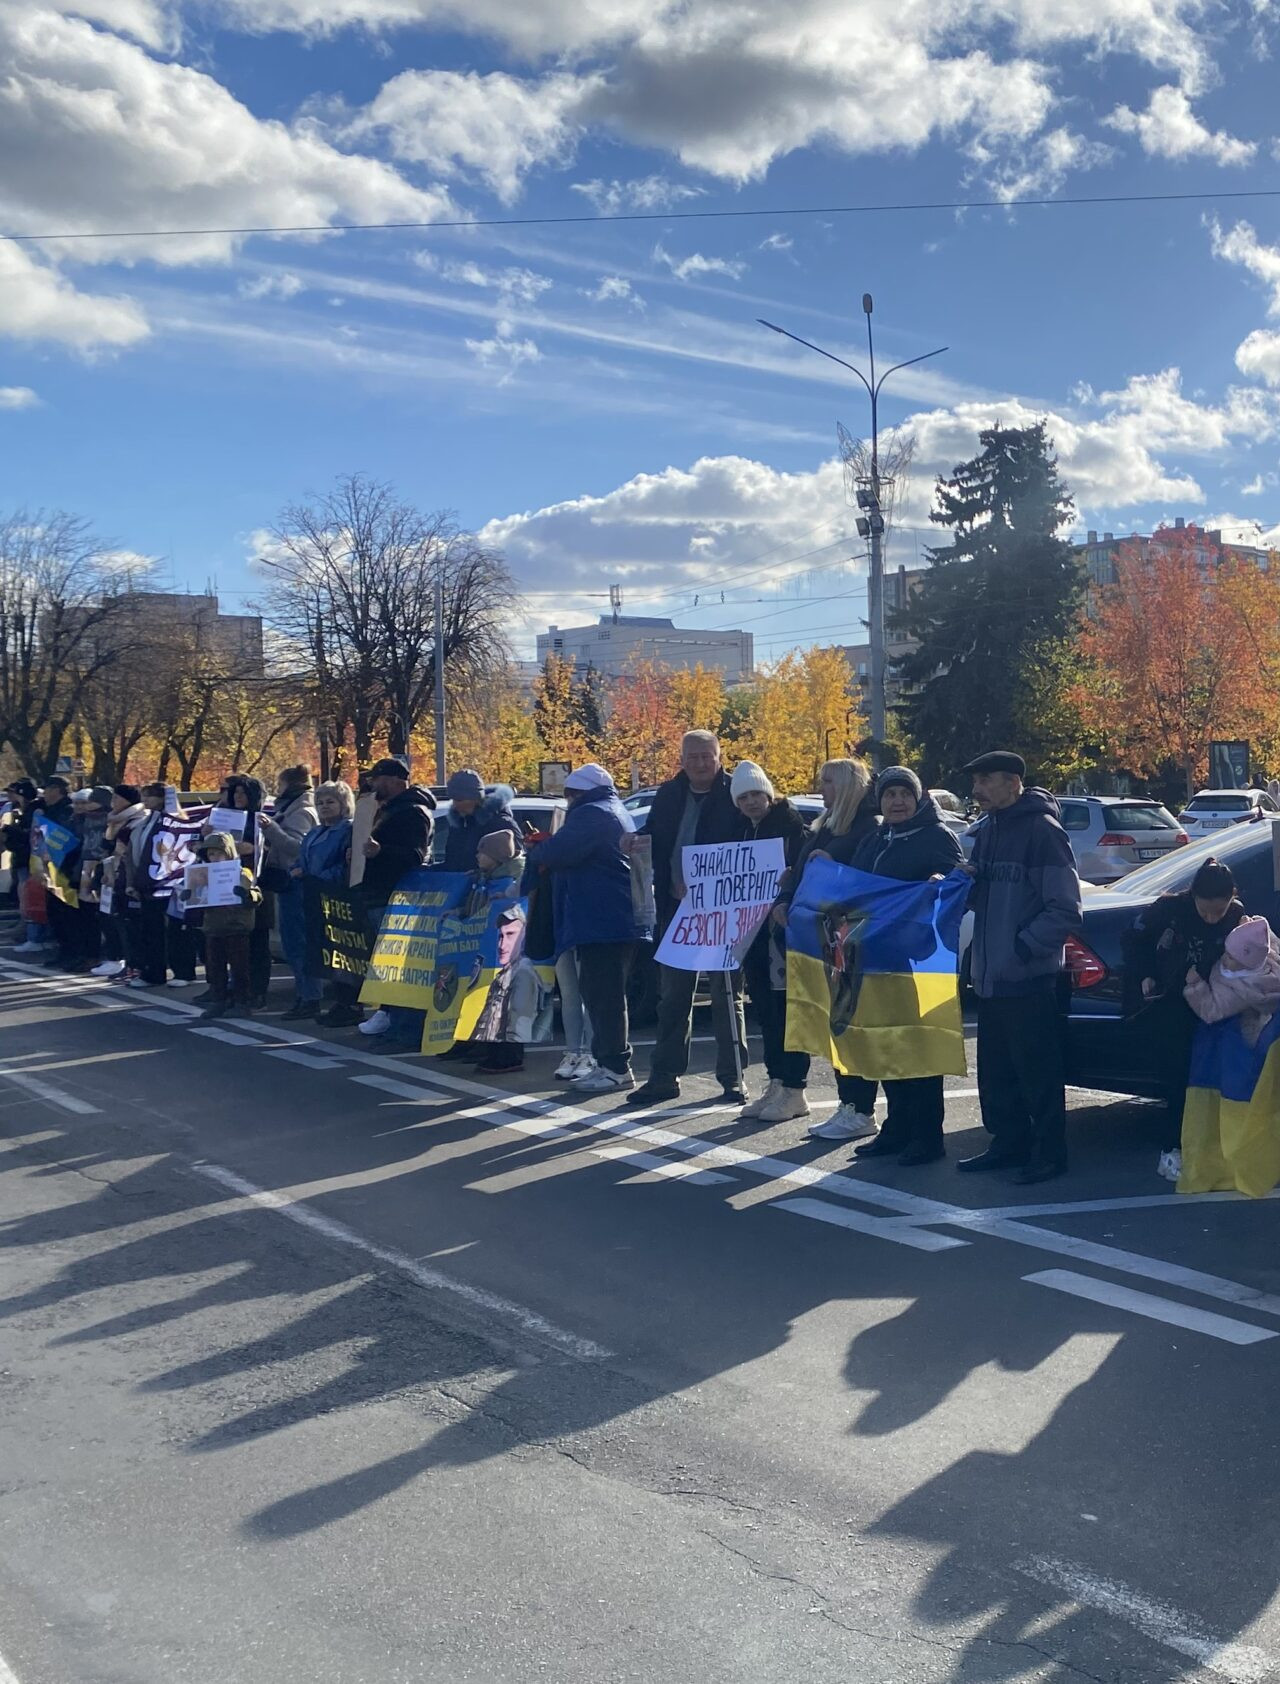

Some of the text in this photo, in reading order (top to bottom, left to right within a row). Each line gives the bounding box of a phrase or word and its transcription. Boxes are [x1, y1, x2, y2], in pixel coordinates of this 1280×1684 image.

[690, 844, 756, 878] ЗНАЙДІТЬ
[689, 864, 780, 910] ТА ПОВЕРНІТЬ
[329, 899, 353, 922] FREE
[672, 911, 728, 947] БЕЗВІСТИ
